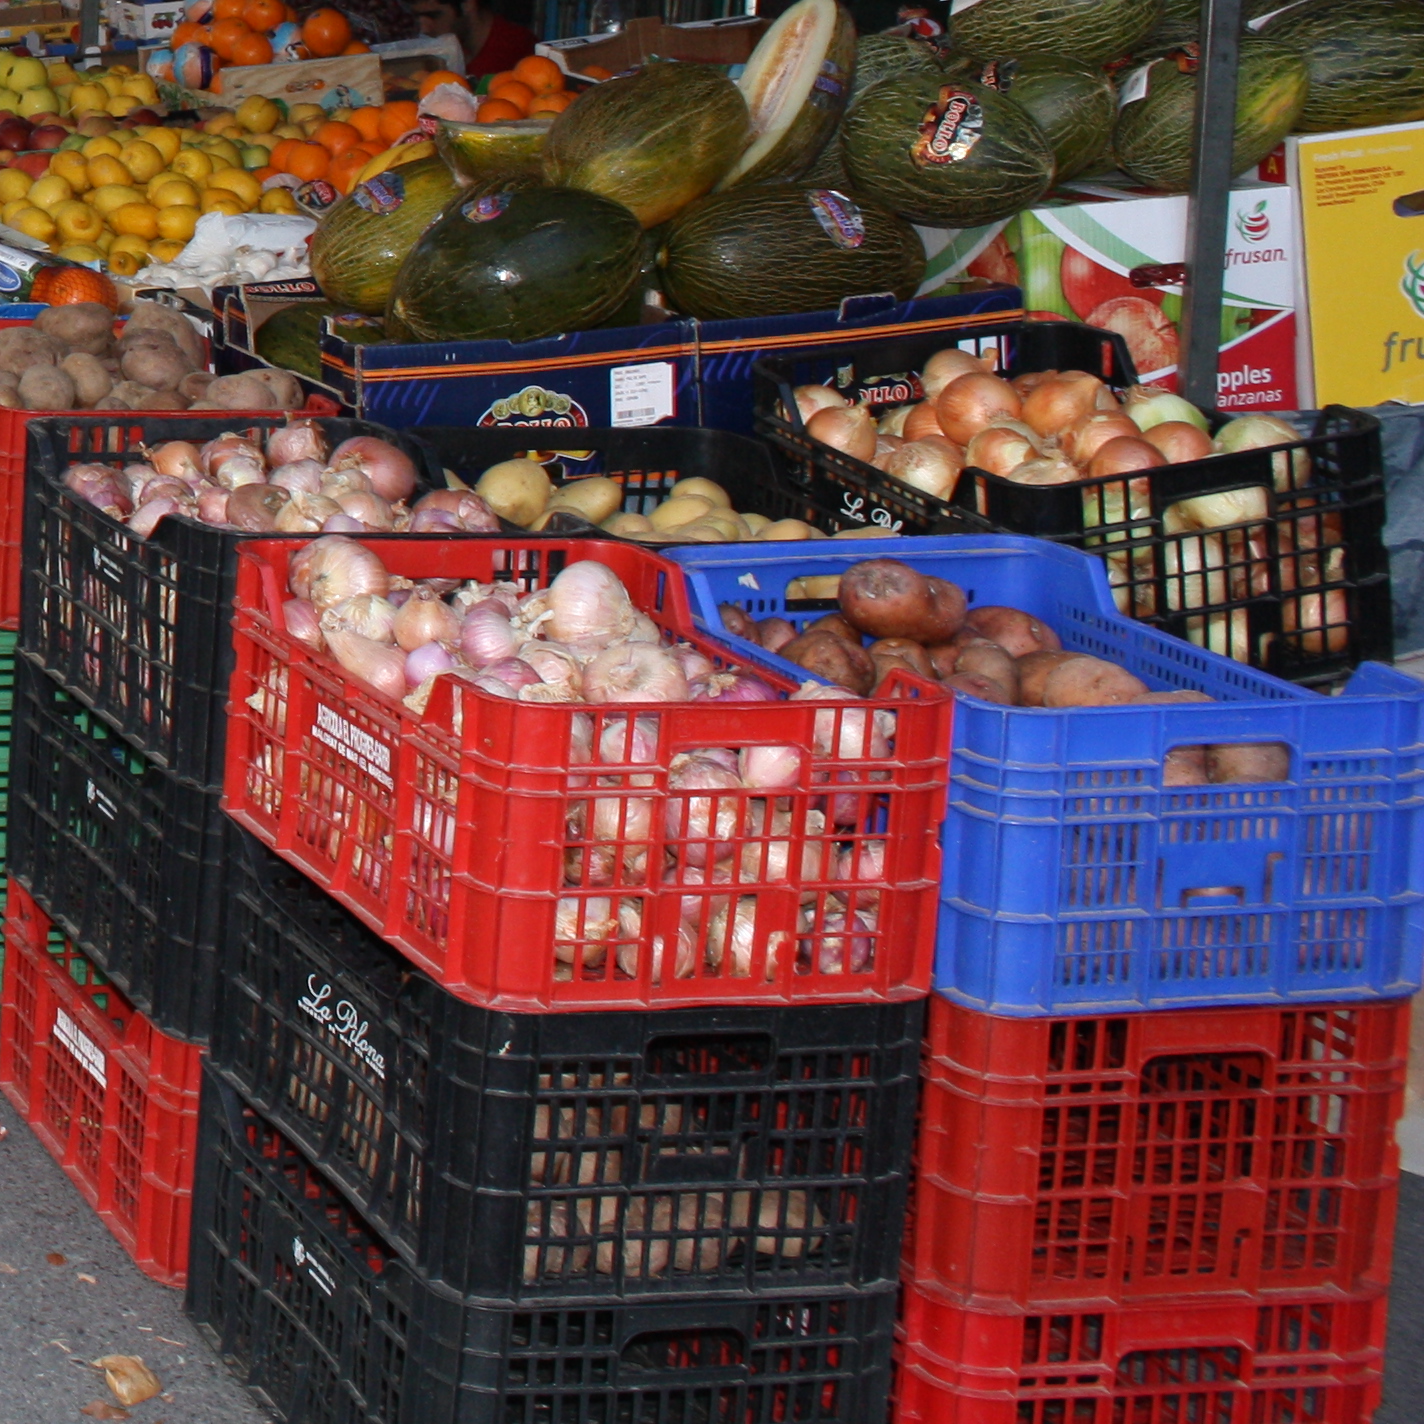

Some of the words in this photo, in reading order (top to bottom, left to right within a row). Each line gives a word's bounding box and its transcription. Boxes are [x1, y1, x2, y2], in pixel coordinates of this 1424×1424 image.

[932, 100, 967, 152] BOLLO
[1381, 331, 1424, 373] fru
[1216, 364, 1272, 393] pples
[1215, 388, 1283, 408] anzanas
[840, 491, 867, 523] La
[301, 973, 333, 1022] La
[334, 999, 386, 1070] Pilona
